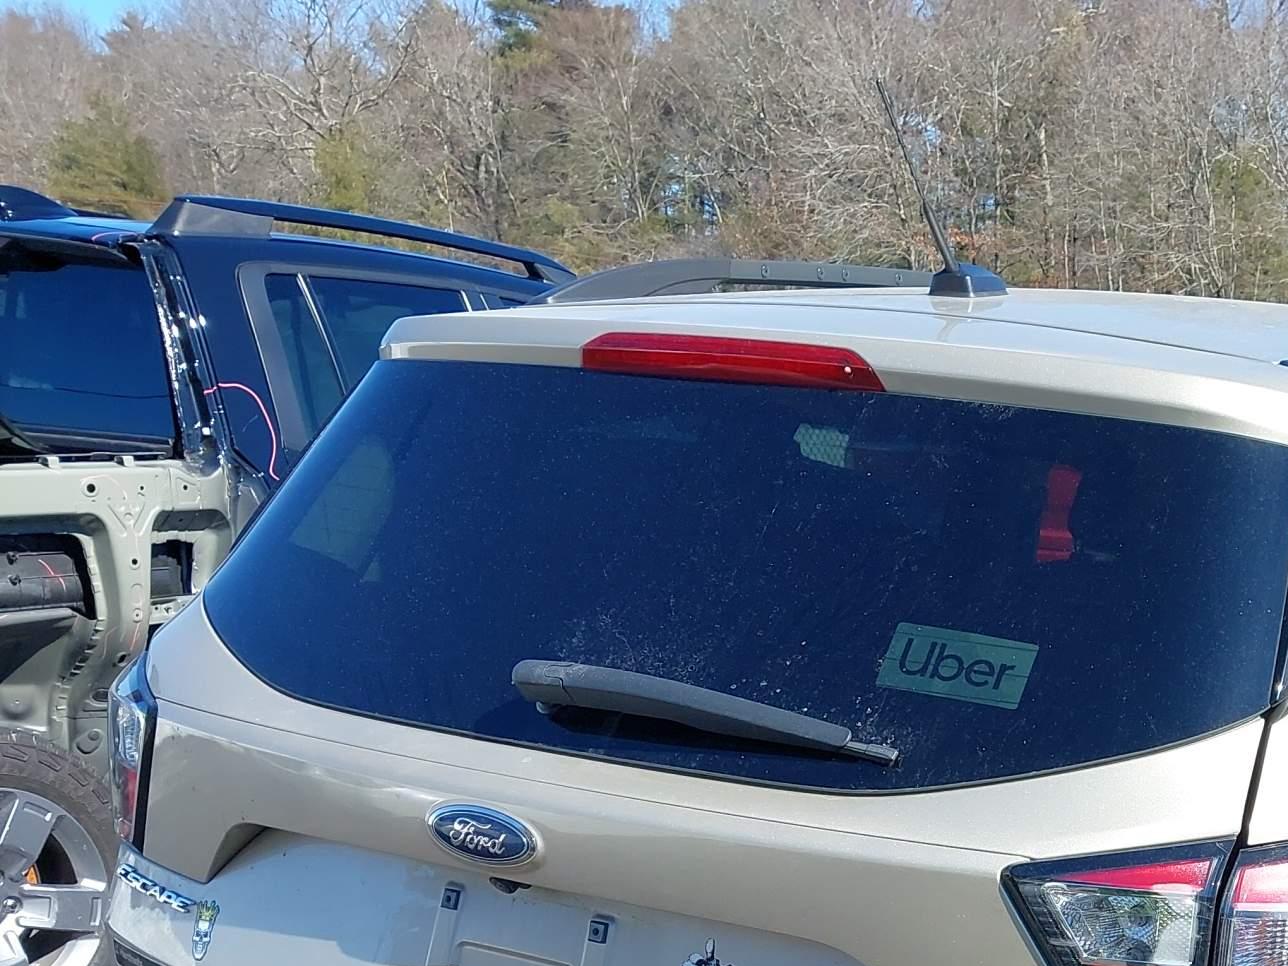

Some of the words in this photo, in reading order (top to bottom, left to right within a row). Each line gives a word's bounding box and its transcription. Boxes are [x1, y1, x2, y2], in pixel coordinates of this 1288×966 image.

[899, 637, 1017, 691] Uber
[449, 817, 506, 855] Ford
[117, 863, 198, 914] ESCAPE
